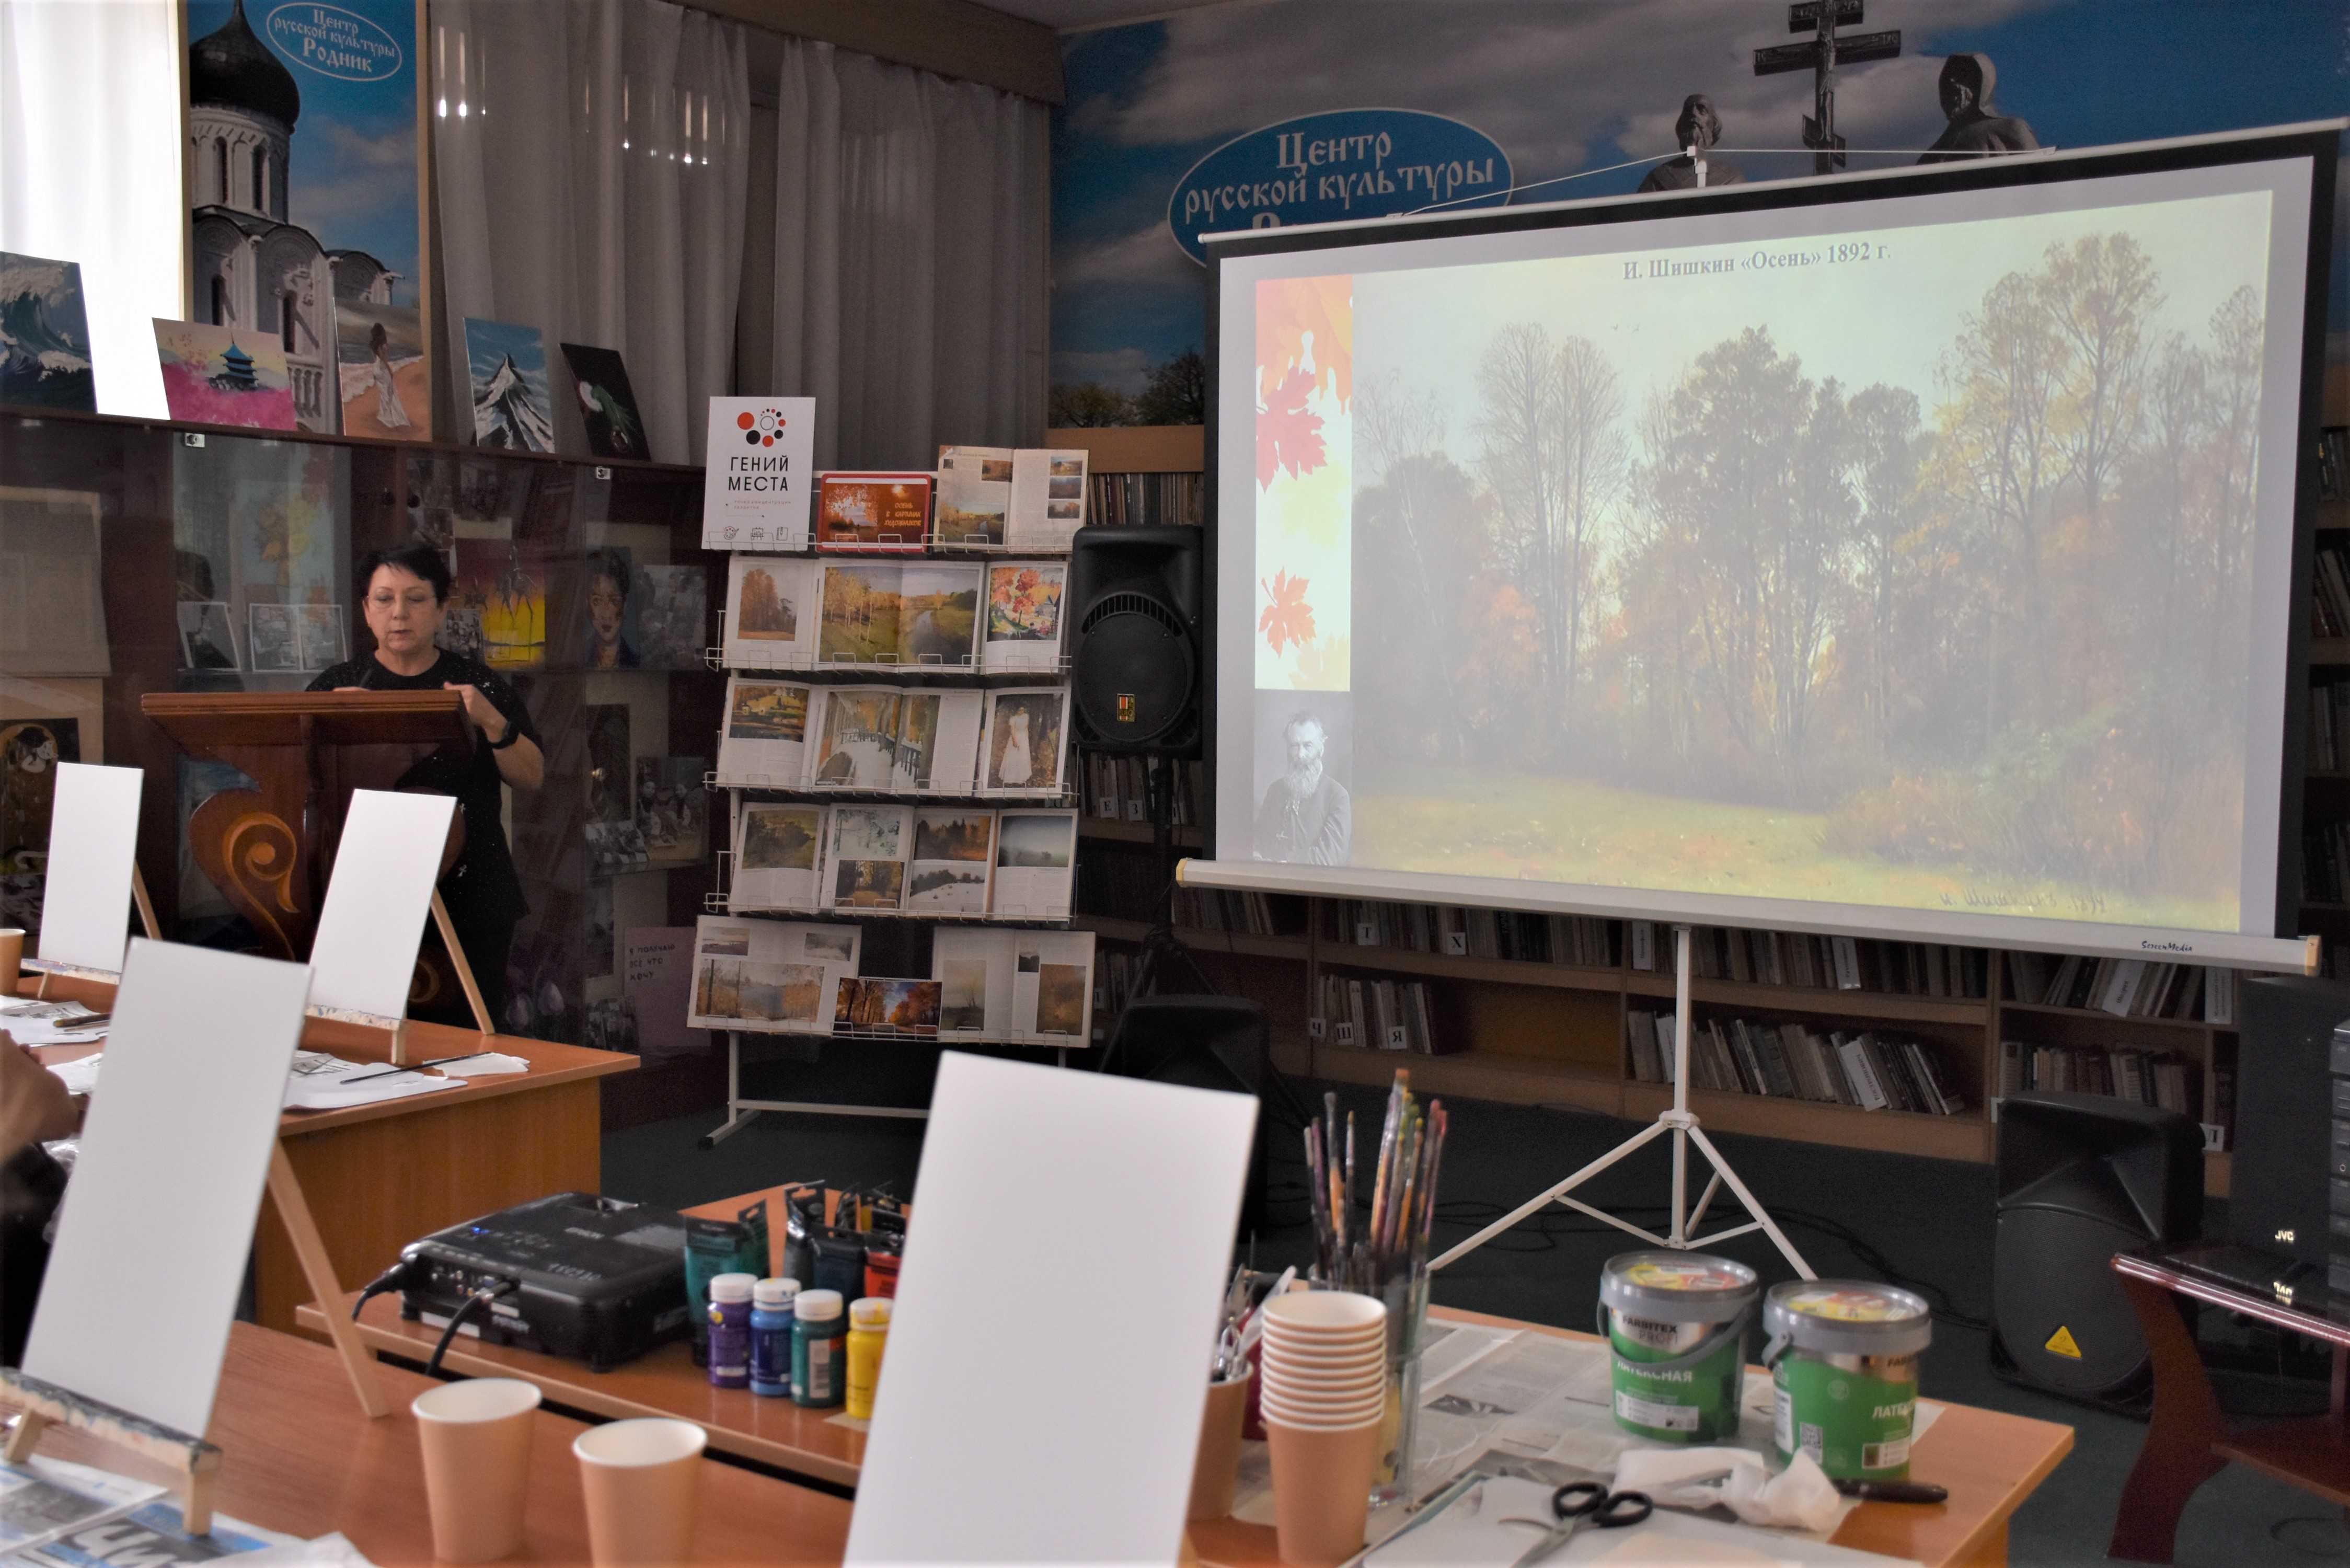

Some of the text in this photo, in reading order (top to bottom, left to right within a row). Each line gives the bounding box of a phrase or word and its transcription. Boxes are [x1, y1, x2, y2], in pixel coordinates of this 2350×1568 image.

[314, 8, 359, 36] Центр
[274, 17, 395, 58] русской культуры
[303, 37, 372, 73] Родник
[1276, 131, 1392, 174] Центр
[1185, 158, 1494, 224] русской культуры
[1622, 242, 1891, 280] И. Шишкин «Осень» 1892 г.
[731, 454, 789, 472] ГЕНИЙ
[728, 476, 789, 492] МЕСТА
[1451, 936, 1462, 948] Х
[2141, 940, 2193, 952] ScreenMedia
[1392, 1031, 1402, 1043] Я
[2275, 1229, 2295, 1243] JVC
[1622, 1315, 1678, 1333] FARBITEX
